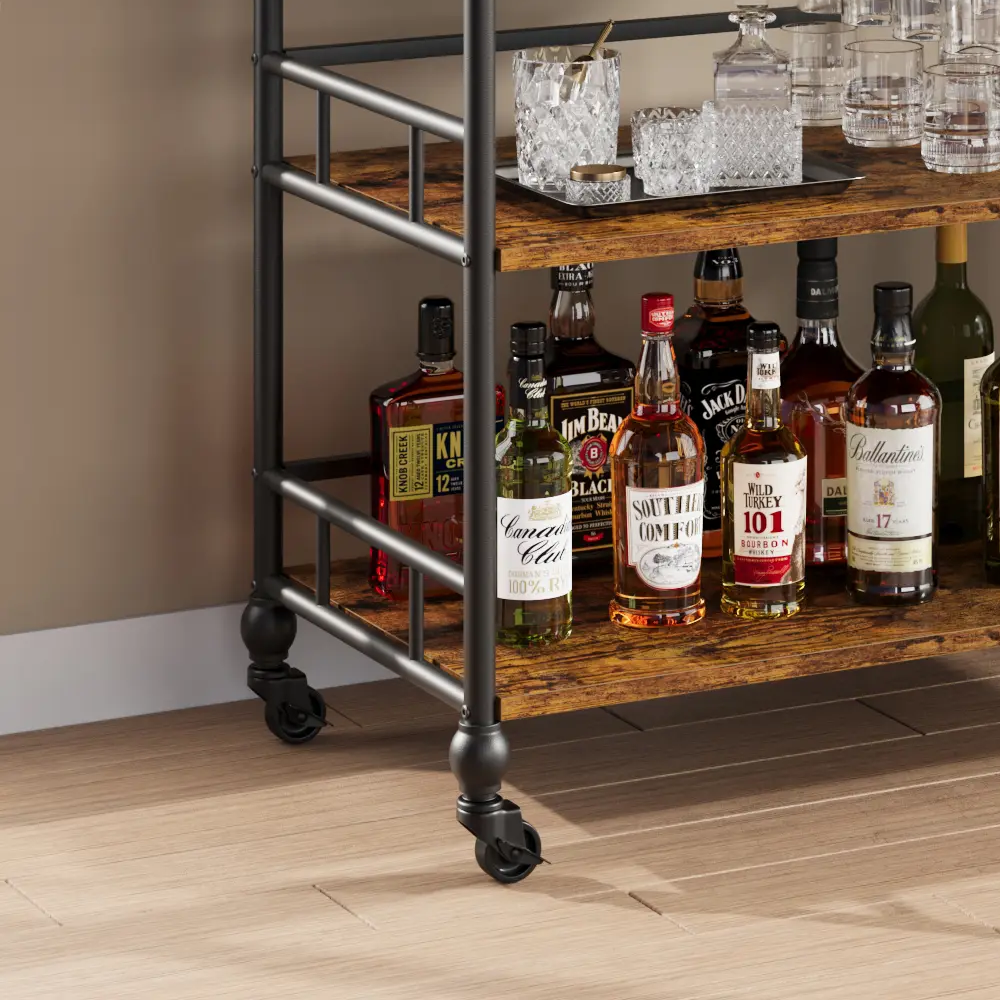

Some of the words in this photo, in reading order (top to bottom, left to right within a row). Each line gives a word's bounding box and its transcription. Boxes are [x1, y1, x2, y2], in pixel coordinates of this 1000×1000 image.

[701, 389, 733, 421] JACK
[561, 415, 587, 443] JIM
[398, 434, 408, 466] CREEK
[436, 431, 462, 460] KN
[446, 457, 465, 469] CR
[398, 467, 408, 493] KNOB
[435, 473, 450, 493] 12
[748, 482, 773, 496] WILD
[743, 493, 782, 509] TURKEY
[744, 511, 784, 534] 101
[876, 514, 891, 528] 17
[741, 539, 789, 549] BOURBON
[509, 578, 545, 595] 100%
